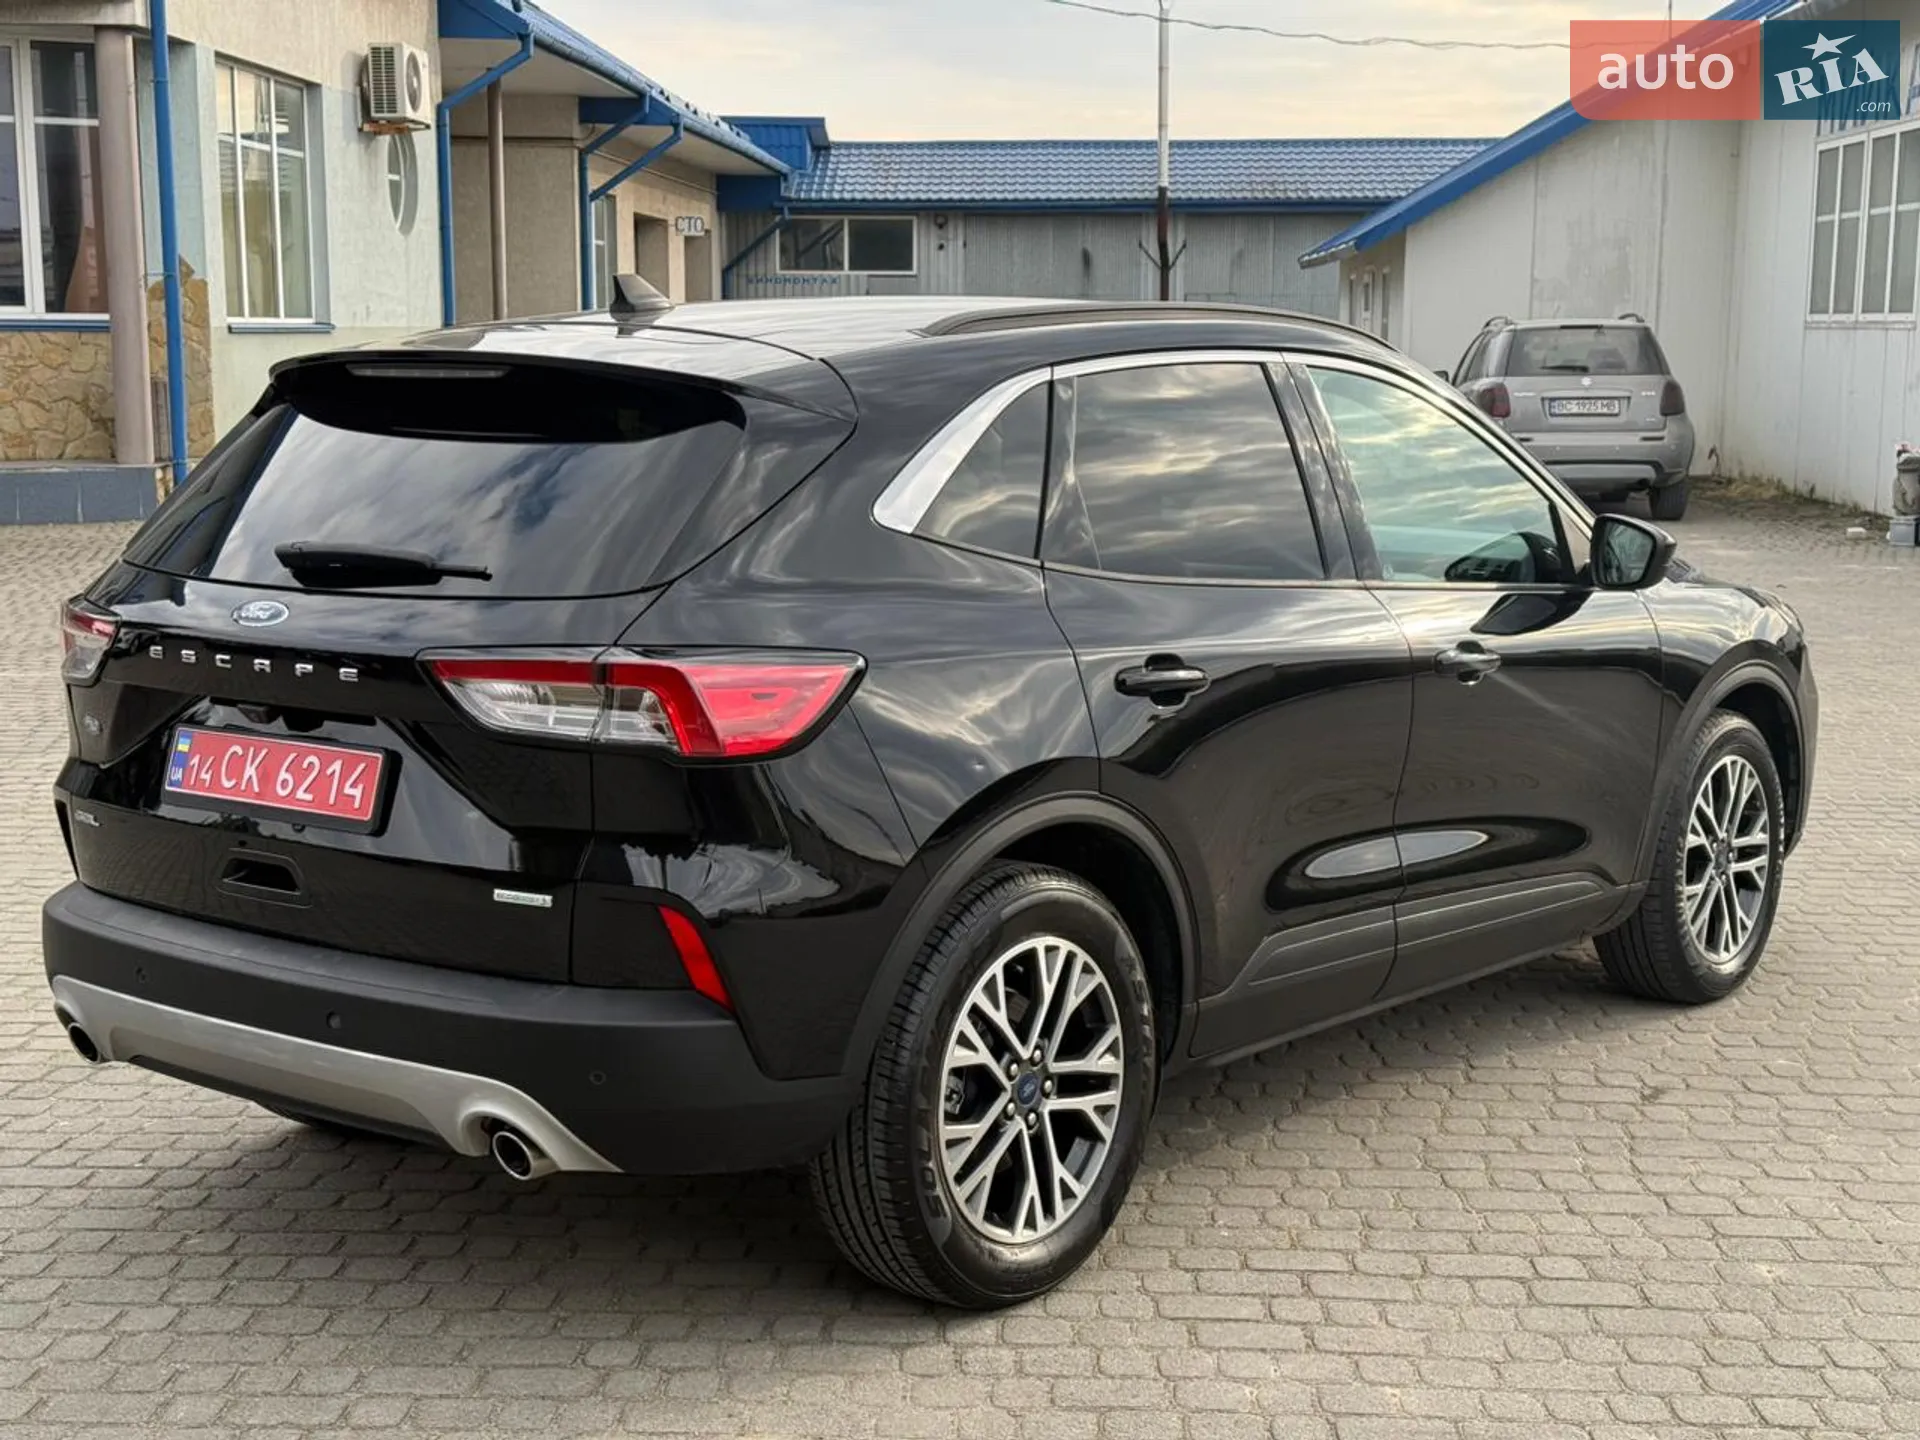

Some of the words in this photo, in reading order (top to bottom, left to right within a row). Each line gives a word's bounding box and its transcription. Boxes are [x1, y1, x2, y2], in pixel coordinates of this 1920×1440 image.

[675, 216, 705, 233] СТО
[1576, 400, 1598, 412] 1925
[149, 645, 359, 682] ESCAPE
[275, 752, 367, 809] 6214
